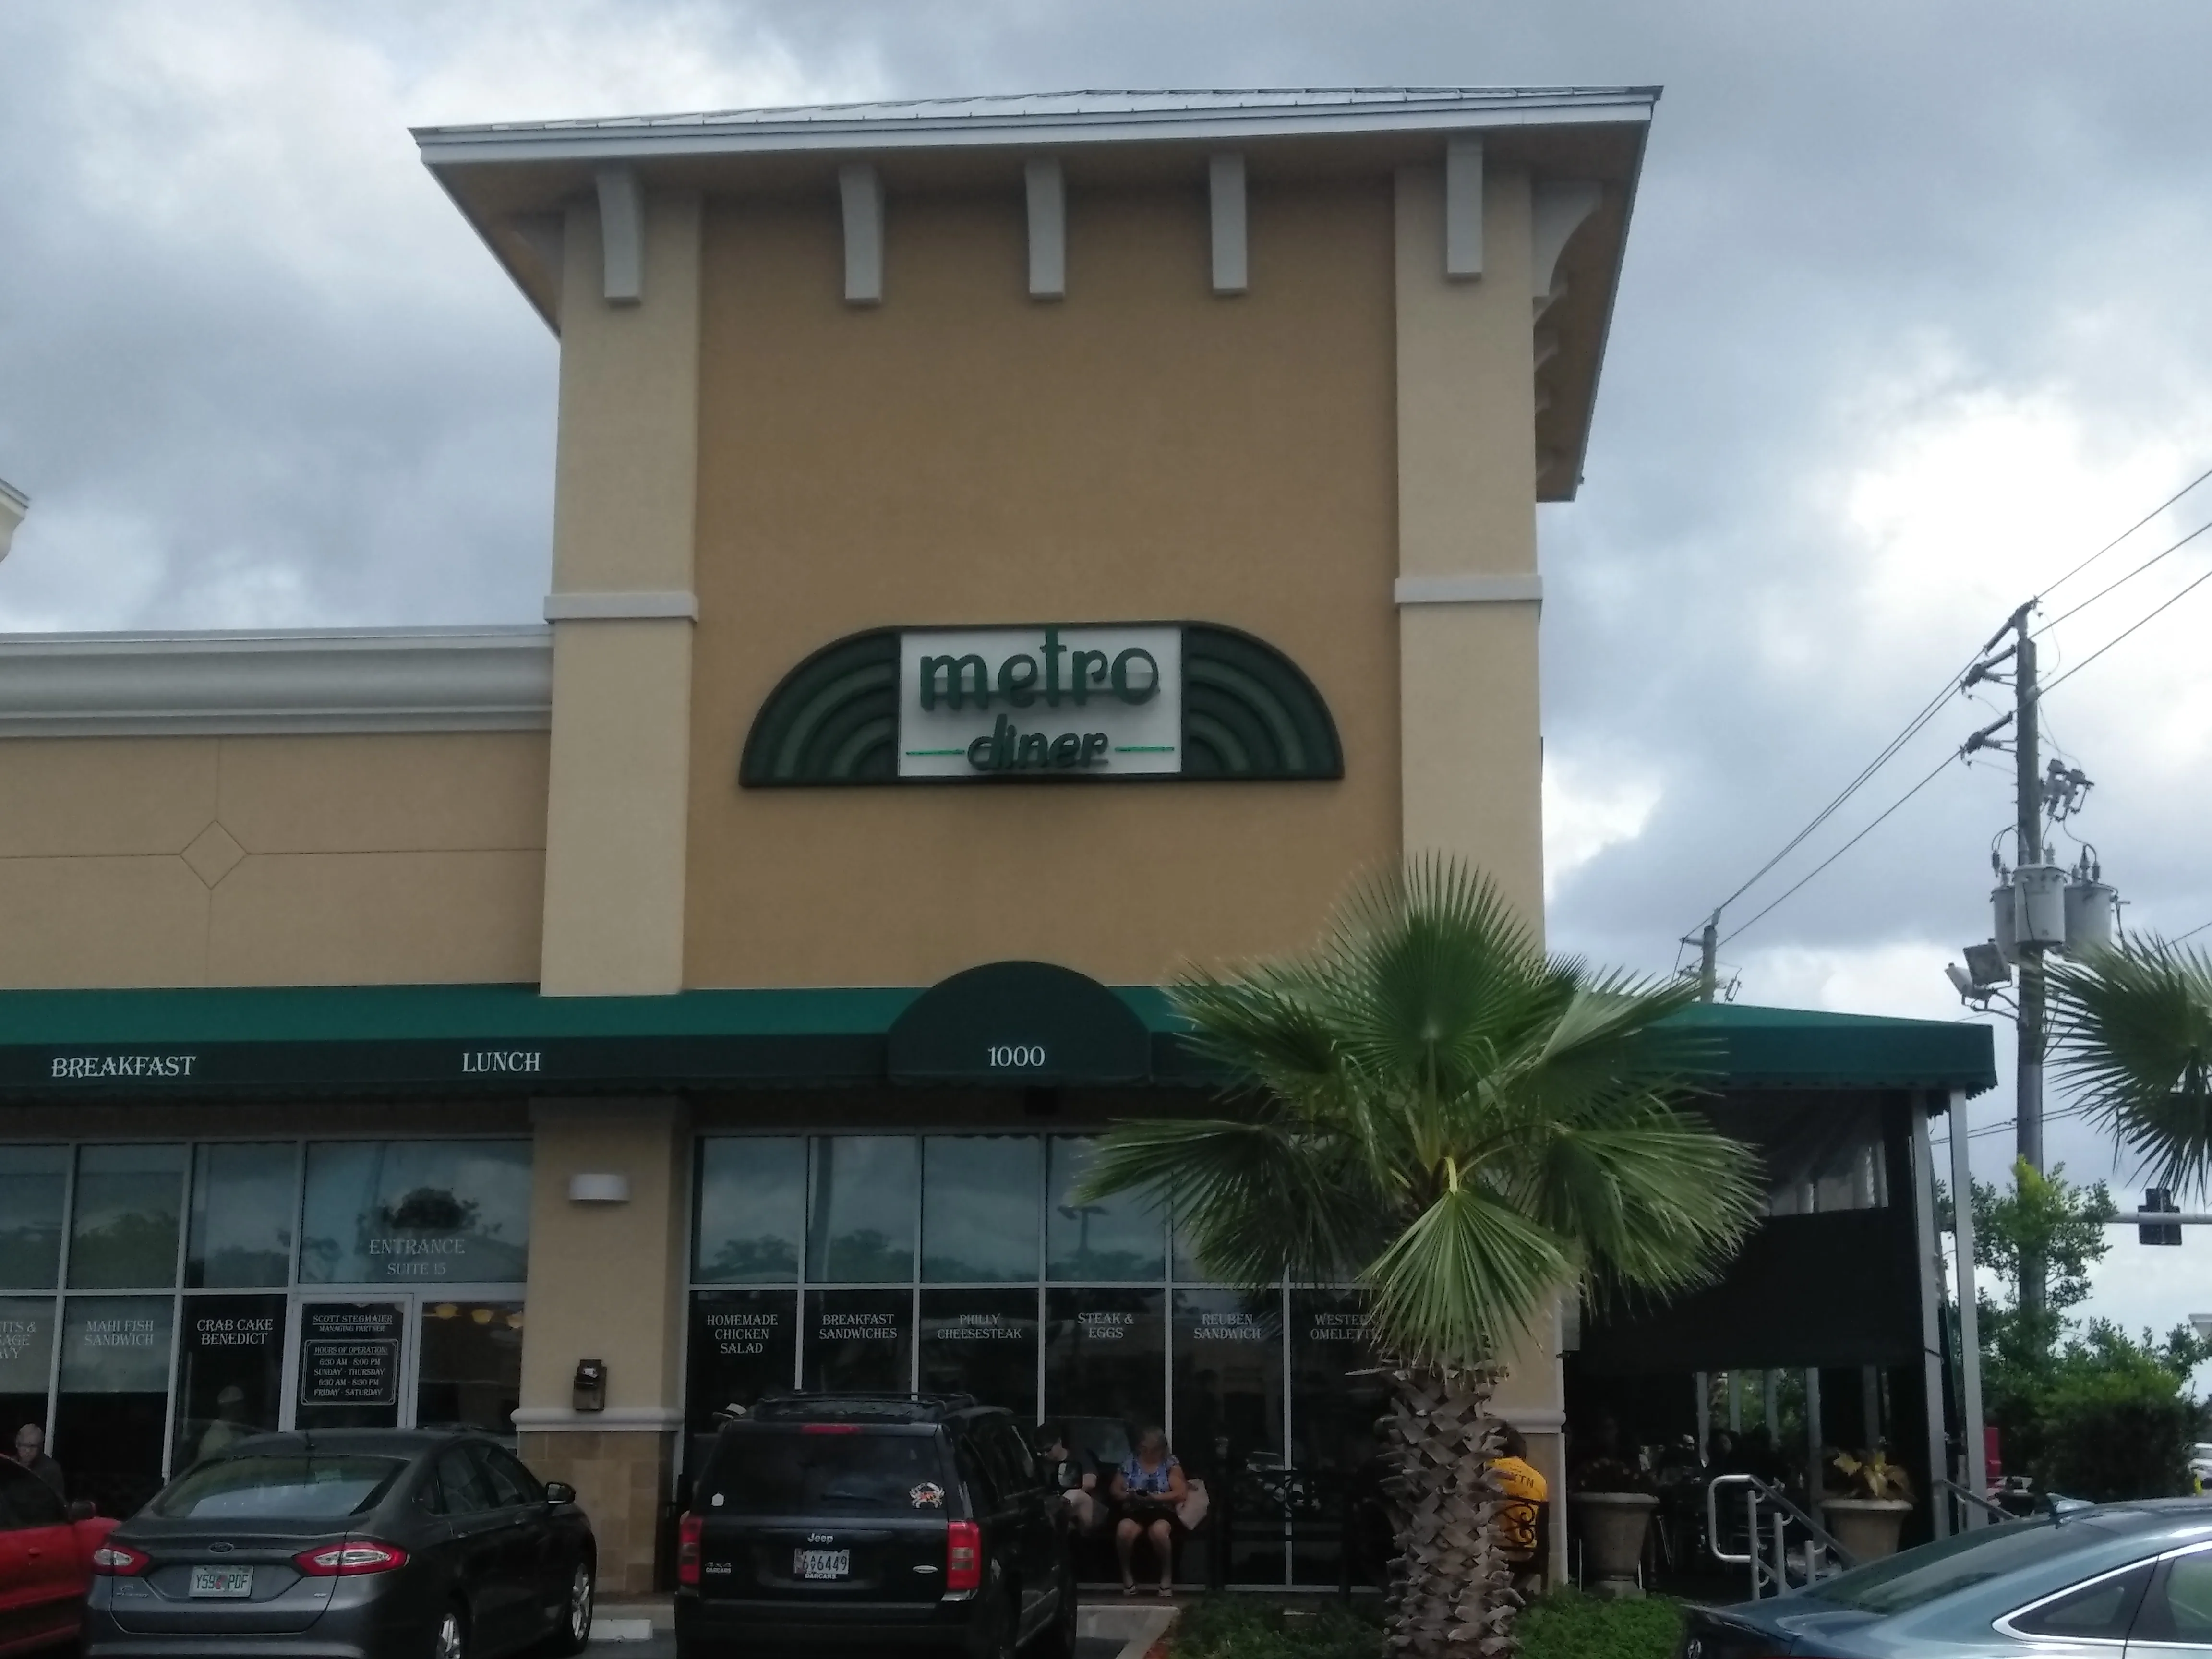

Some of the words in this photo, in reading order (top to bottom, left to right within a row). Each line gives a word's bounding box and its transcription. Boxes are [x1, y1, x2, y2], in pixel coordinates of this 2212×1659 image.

[920, 625, 1159, 710] metro
[967, 714, 1108, 770] diner
[462, 1051, 541, 1072] LUNCH
[987, 1046, 1045, 1067] 1000
[51, 1056, 196, 1078] BREAKFAST
[369, 1238, 465, 1255] ENTRANCE
[386, 1262, 428, 1275] SUITE
[433, 1262, 445, 1275] 15
[313, 1314, 340, 1323] SCOTT
[341, 1314, 393, 1323] STEGMAIER
[707, 1314, 778, 1326] HOMEMADE
[822, 1314, 894, 1326] BREAKFAST
[959, 1313, 1000, 1325] PHILLY
[1077, 1313, 1119, 1324] STEAK
[1124, 1313, 1134, 1324] &
[1202, 1313, 1252, 1325] REUBEN
[1315, 1313, 1374, 1325] WESTE
[0, 1321, 23, 1333] ITS
[26, 1321, 36, 1333] &
[86, 1320, 120, 1332] MAHI
[124, 1320, 153, 1332] FISH
[196, 1319, 234, 1332] CRAB
[236, 1319, 273, 1331] CAKE
[201, 1332, 268, 1345] BENEDICT
[715, 1328, 769, 1340] CHICKEN
[819, 1327, 898, 1339] SANDWICHES
[937, 1328, 1022, 1339] CHEESESTEAK
[1088, 1328, 1124, 1339] EGGS
[1193, 1327, 1262, 1339] SANDWICH
[0, 1334, 30, 1346] AGE
[84, 1333, 153, 1346] SANDWICH
[720, 1342, 763, 1354] SALAD
[314, 1368, 343, 1376] SUNDAY
[348, 1368, 386, 1376] THURSDAY
[314, 1388, 340, 1396] FRIDAY
[807, 1533, 834, 1544] Jeep
